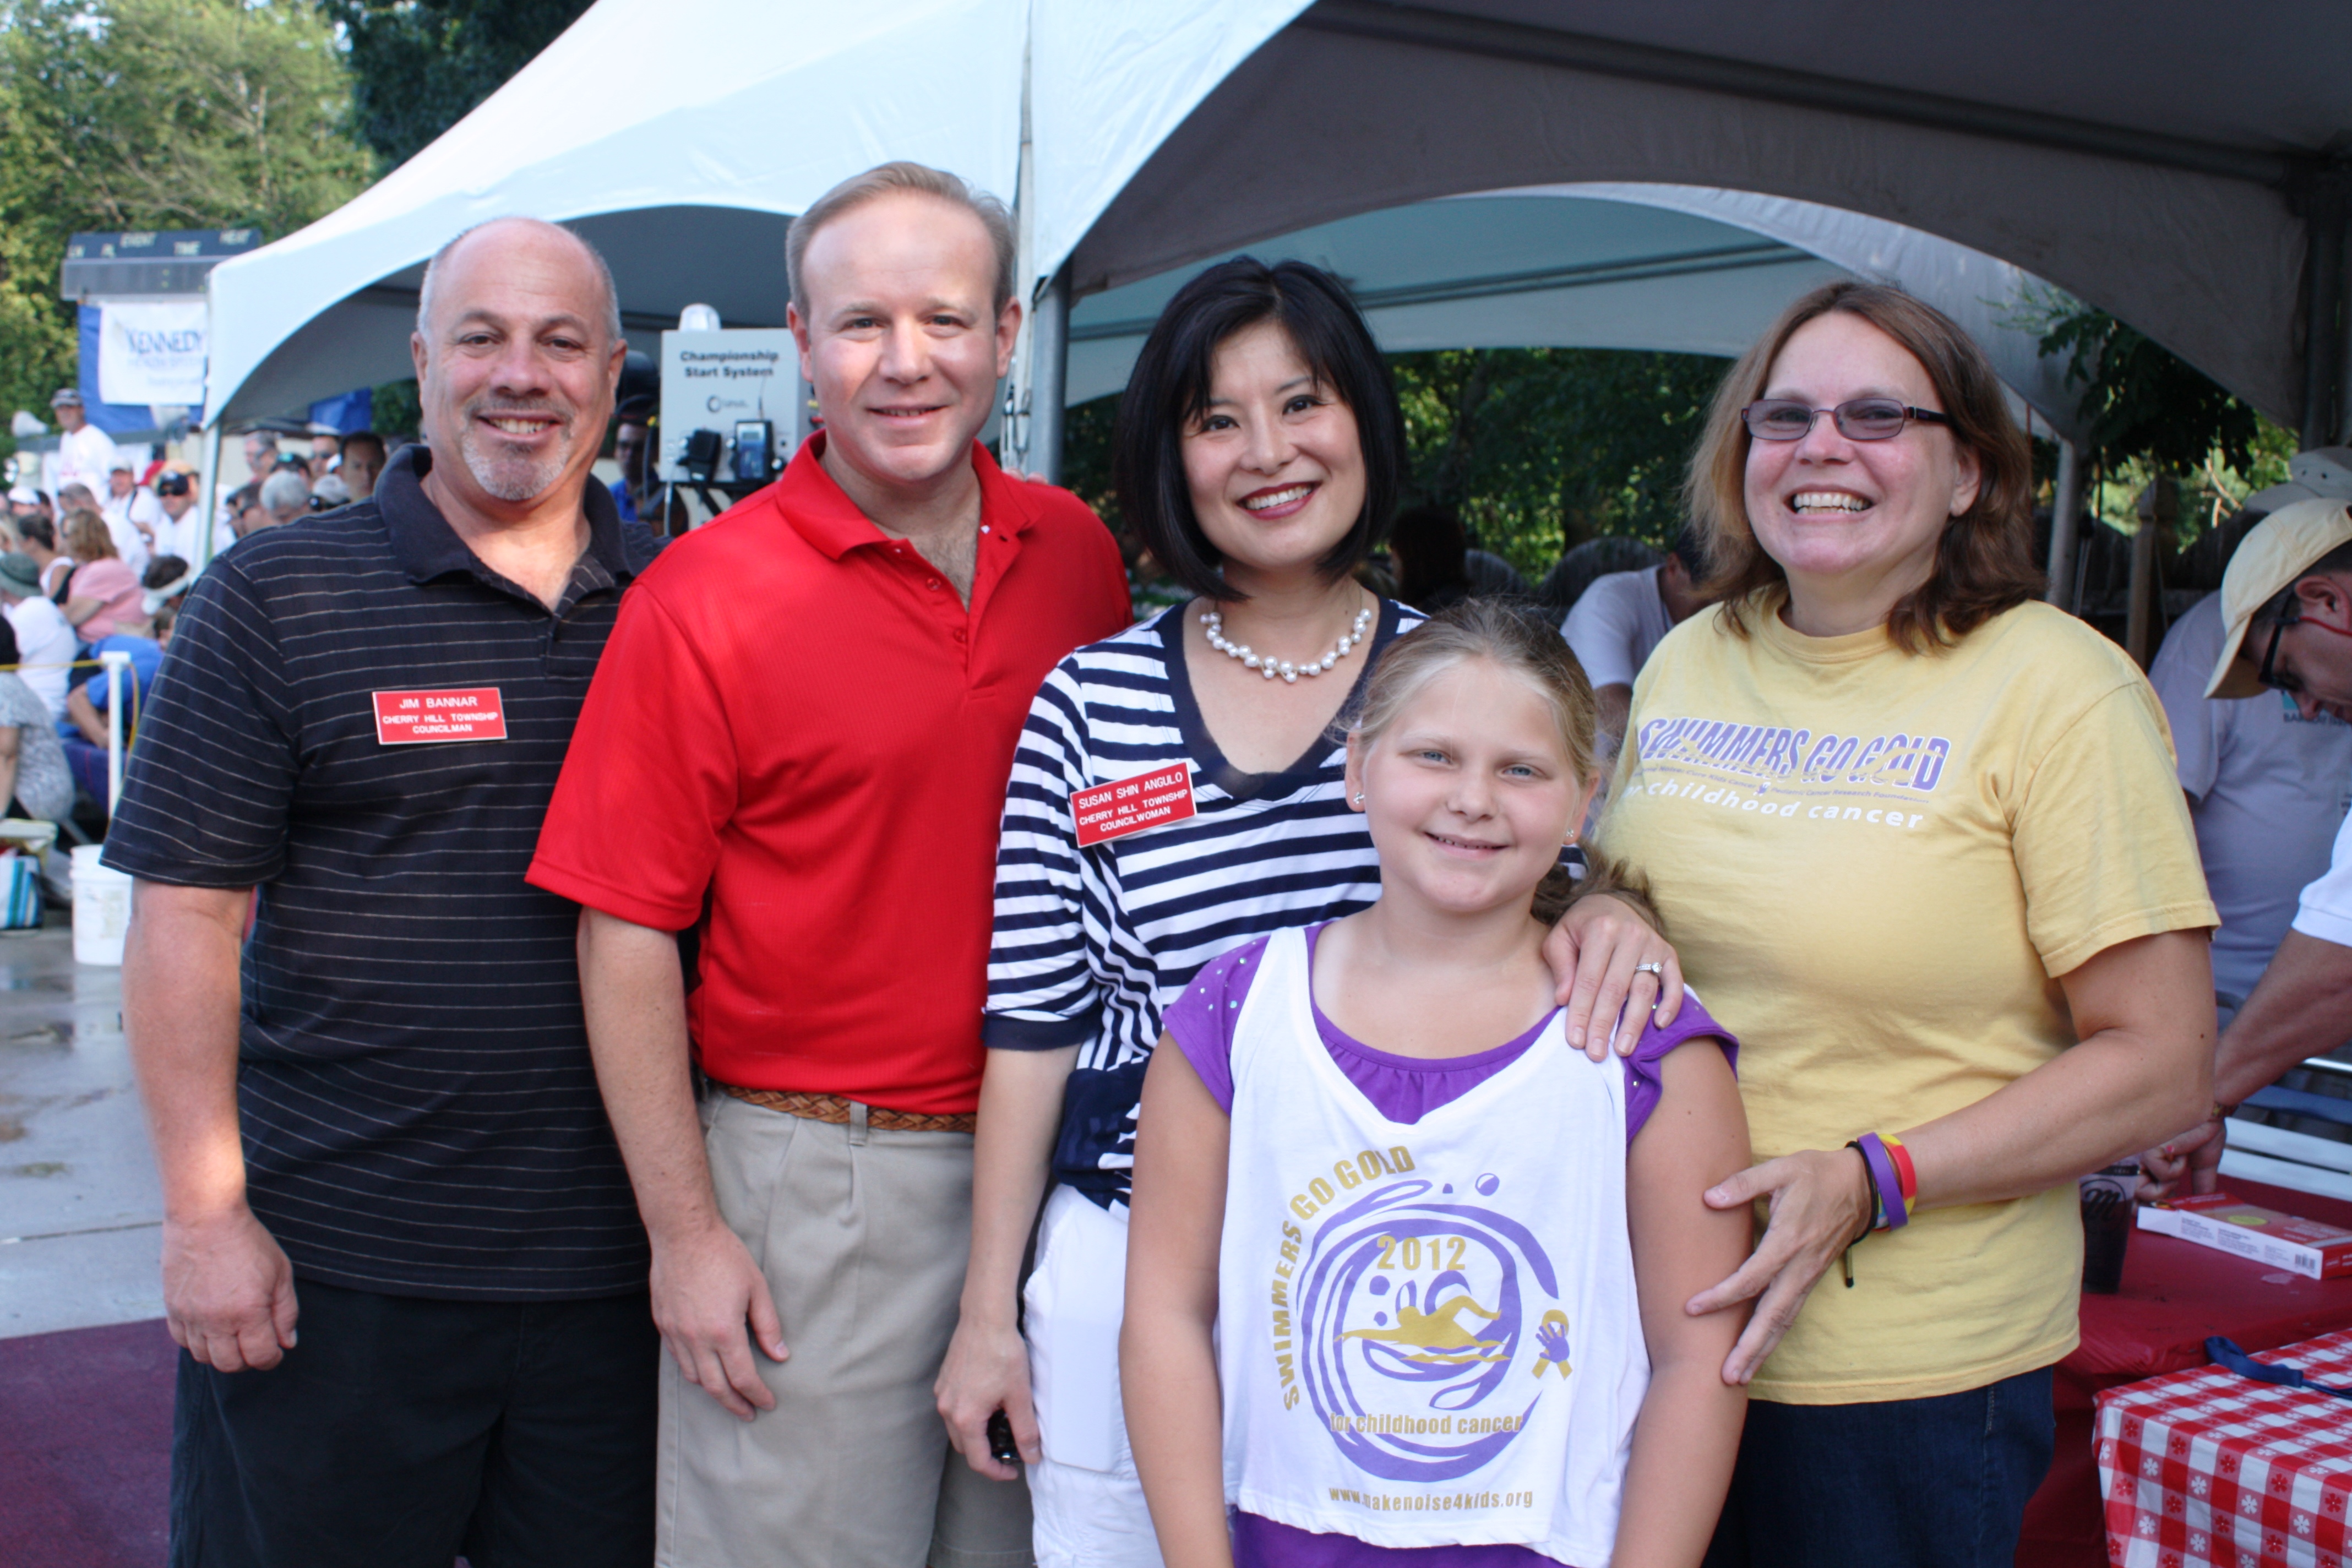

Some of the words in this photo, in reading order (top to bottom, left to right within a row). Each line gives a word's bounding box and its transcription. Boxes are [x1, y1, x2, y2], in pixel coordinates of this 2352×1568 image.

[680, 349, 779, 364] Championship
[685, 366, 718, 379] Start
[723, 365, 774, 380] System
[399, 698, 420, 709] JIM
[426, 696, 478, 709] BANNAR
[382, 715, 420, 725] CHERRY
[424, 714, 445, 723] HILL
[450, 711, 499, 722] TOWNSHIP
[412, 723, 473, 734] COUNCILMAN
[1638, 717, 1811, 783] SWIMMERS
[1800, 733, 1860, 783] GO
[1846, 732, 1952, 793] GOLD
[1079, 792, 1113, 809] SUSAN
[1116, 783, 1140, 799] SHIN
[1144, 771, 1184, 792] ANGULO
[1708, 774, 1727, 783] Kids
[1728, 778, 1756, 788] Cancer
[1832, 789, 1872, 797] Research
[1079, 809, 1114, 826] CHERRY
[1117, 803, 1138, 815] HILL
[1142, 789, 1188, 809] TOWNSHIP
[1648, 778, 1801, 818] childhood
[1808, 804, 1924, 829] cancer
[1099, 805, 1172, 832] COUNCILWOMAN
[1376, 1235, 1467, 1271] 2012
[1271, 1219, 1303, 1411] SWIMMERS
[1289, 1177, 1335, 1221] GO
[1333, 1145, 1416, 1190] GOLD
[1330, 1411, 1351, 1432] for
[1355, 1413, 1452, 1435] childhood
[1457, 1414, 1523, 1435] cancer
